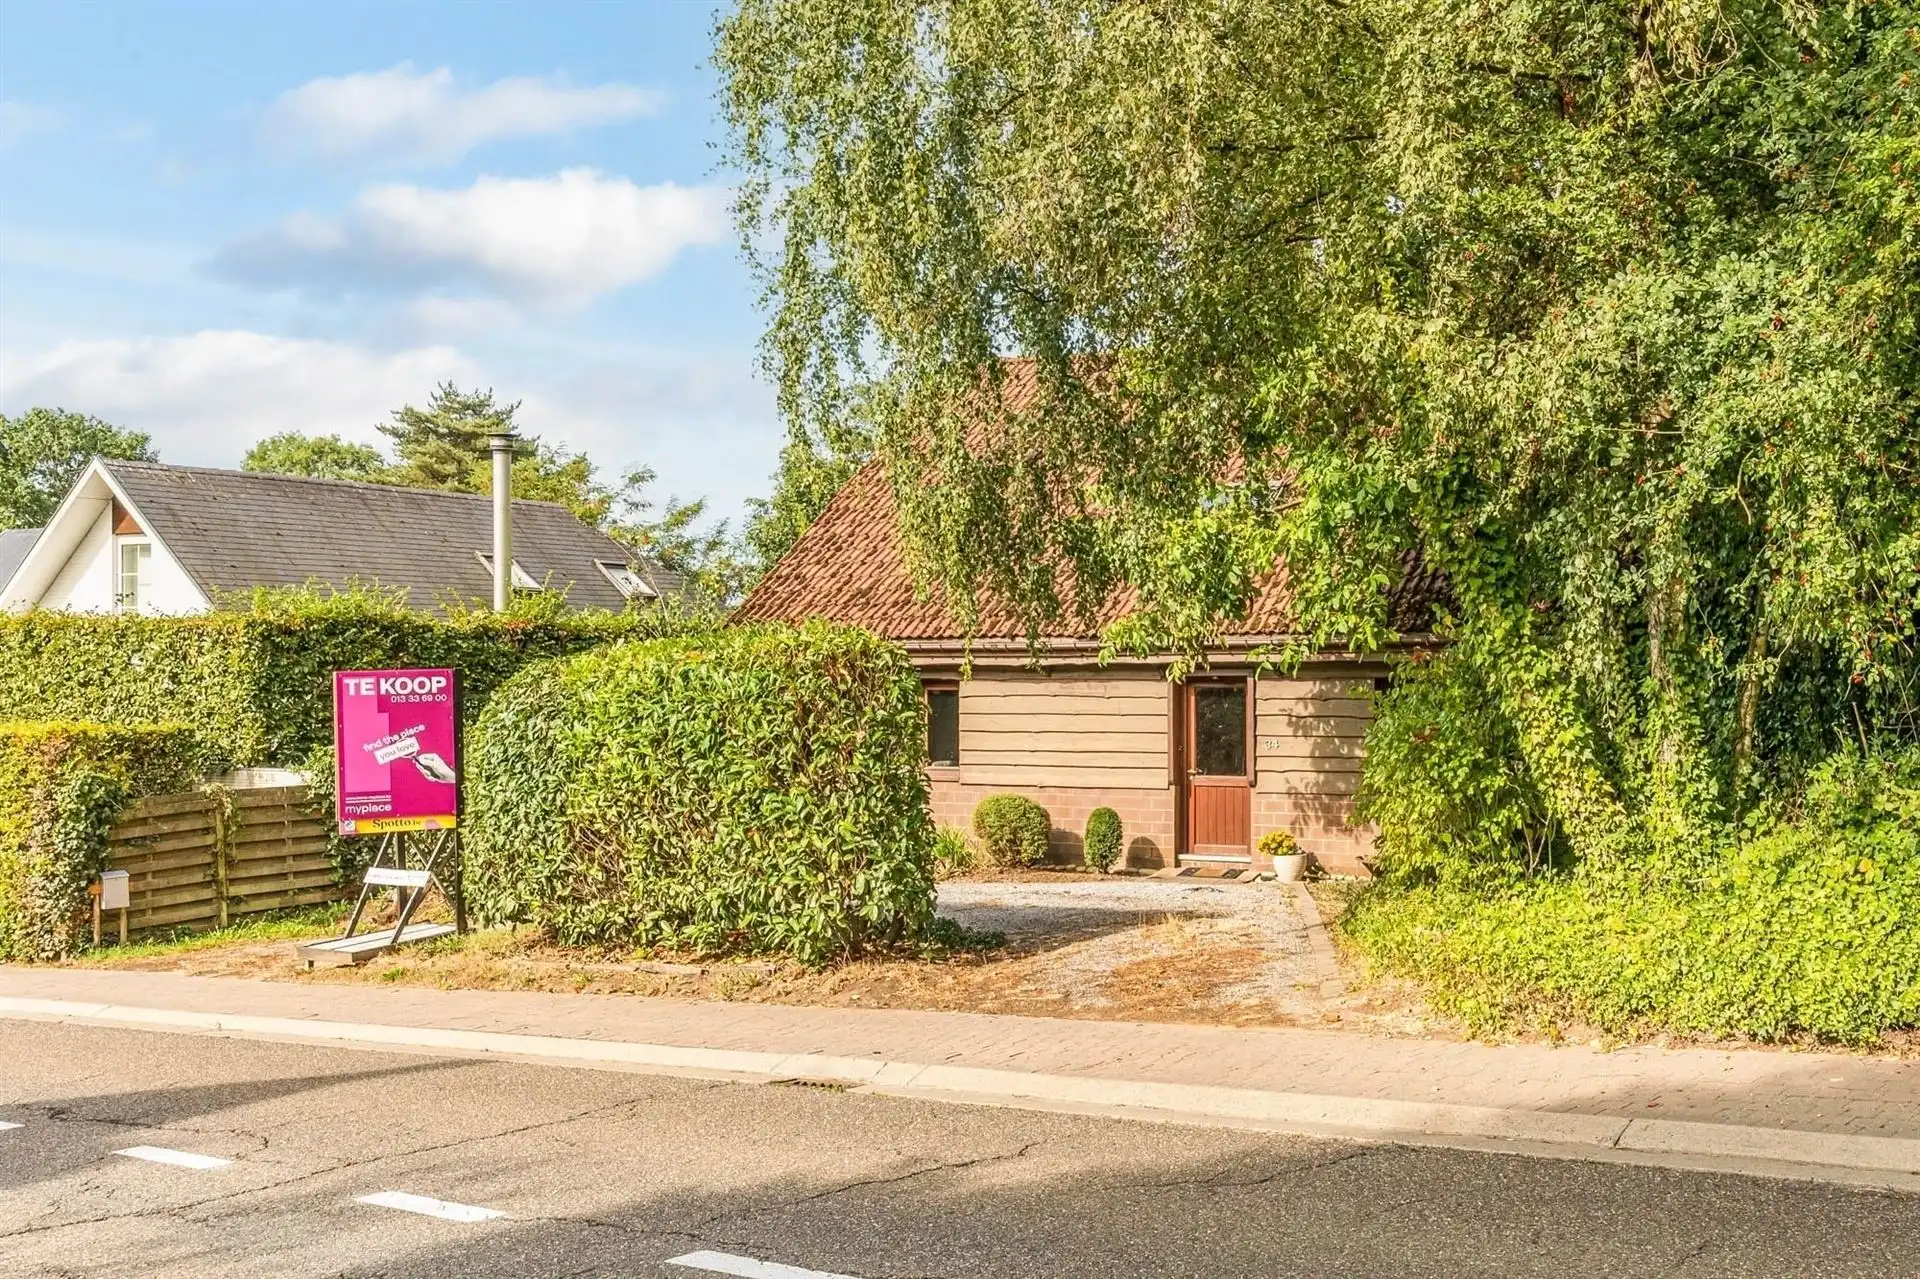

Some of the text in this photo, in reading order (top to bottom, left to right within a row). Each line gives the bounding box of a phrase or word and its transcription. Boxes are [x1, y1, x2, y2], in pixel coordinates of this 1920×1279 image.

[343, 676, 447, 696] TE KOOP
[391, 694, 447, 703] 013 33 69 00
[363, 724, 425, 753] find the place
[1264, 739, 1280, 750] 34
[380, 742, 415, 761] you love
[345, 803, 392, 815] myplace
